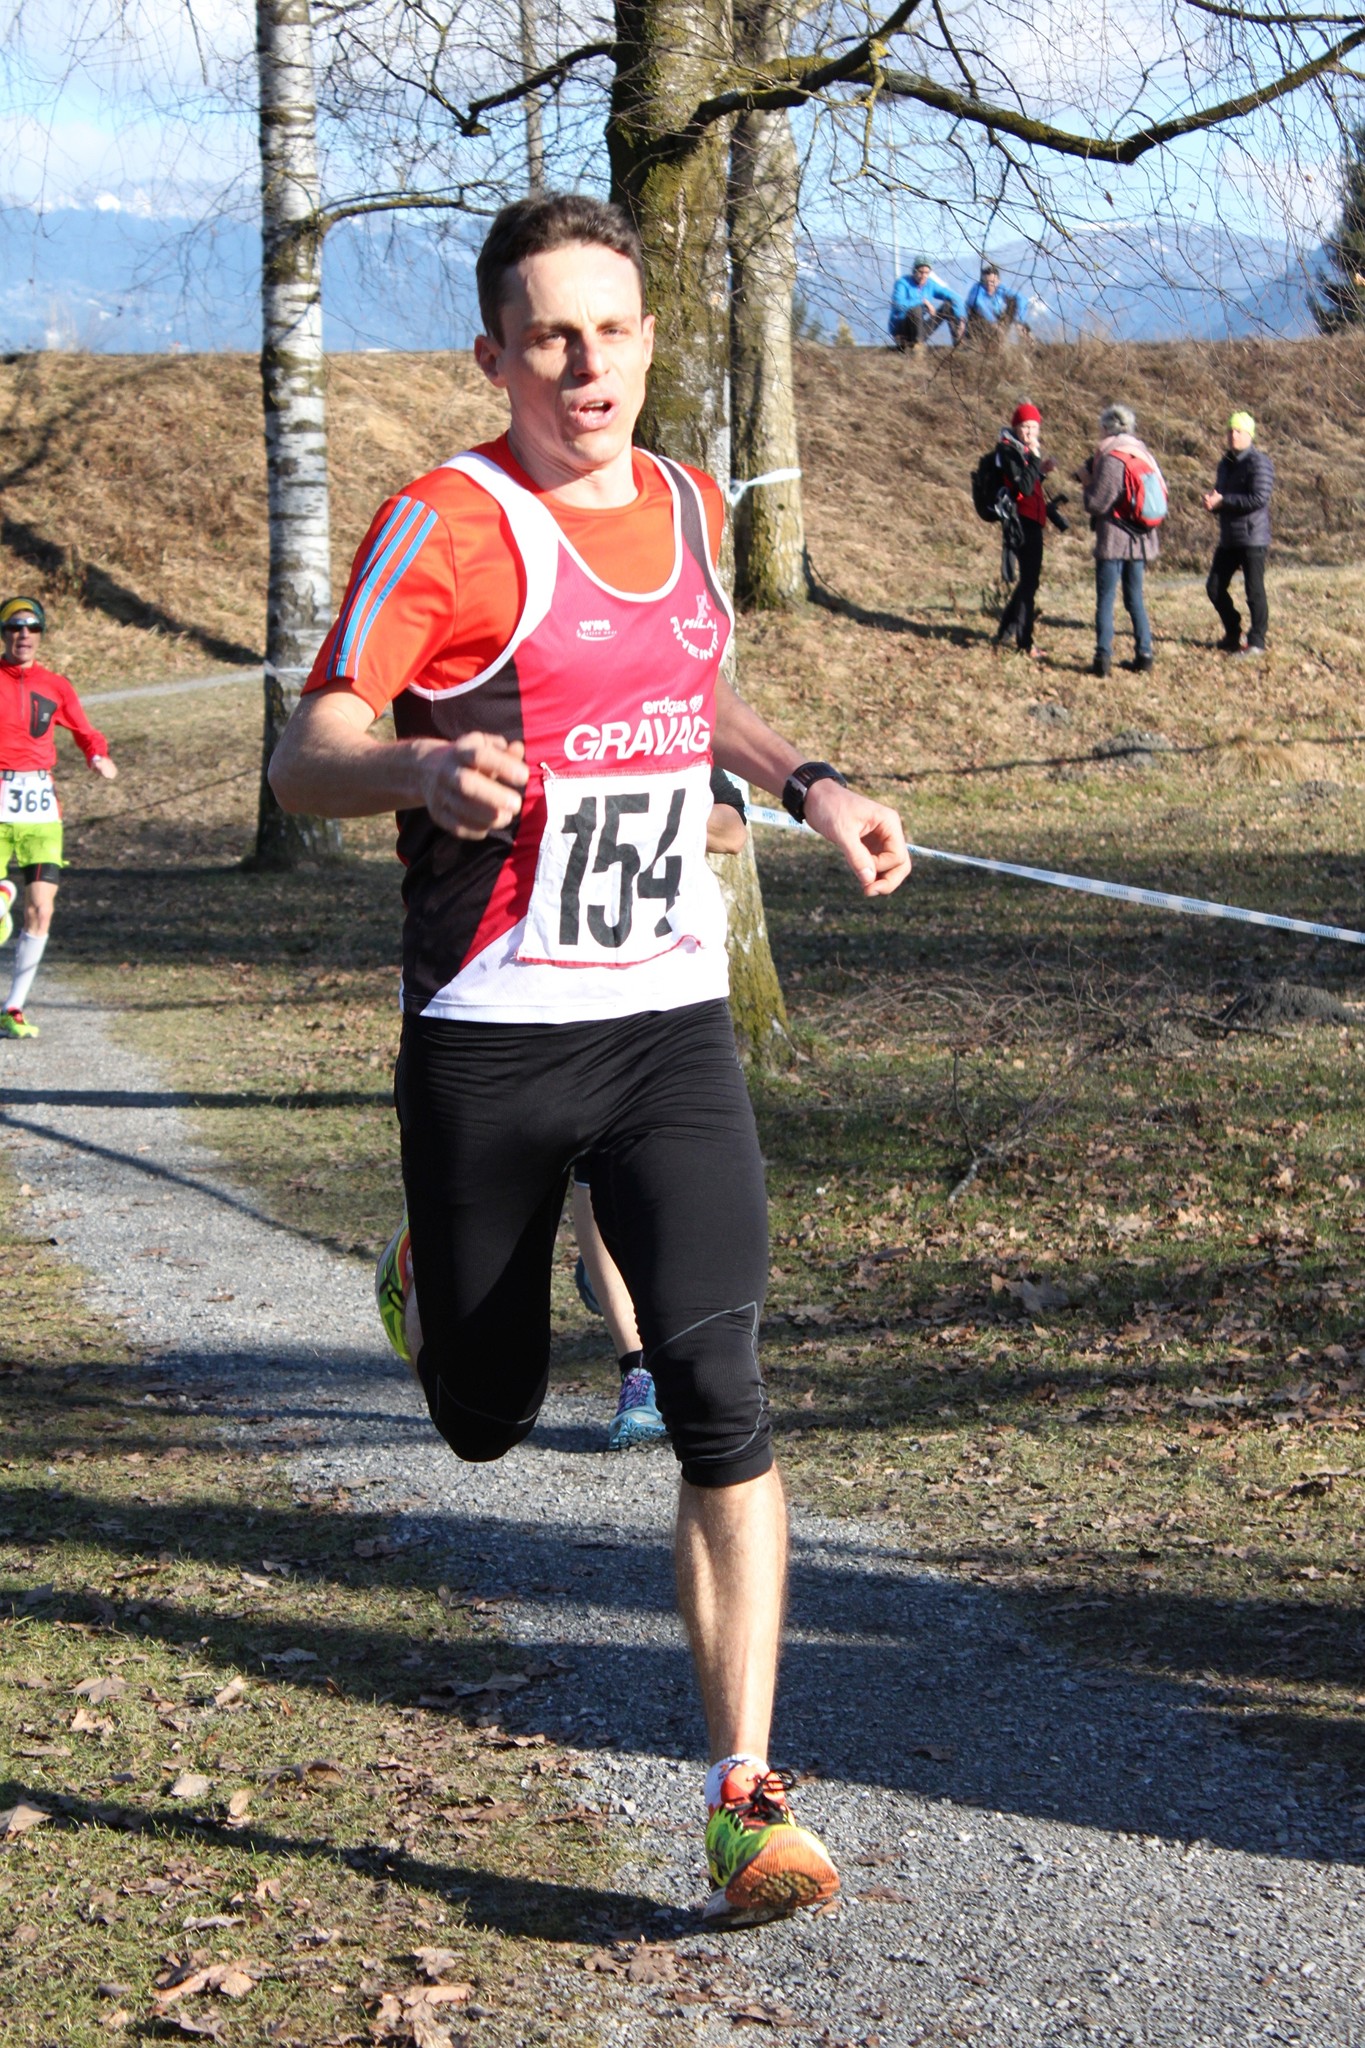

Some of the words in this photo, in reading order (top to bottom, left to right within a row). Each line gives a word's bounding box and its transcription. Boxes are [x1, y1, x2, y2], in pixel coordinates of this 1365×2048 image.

[642, 696, 688, 717] erdgas
[563, 715, 711, 762] GRAVAG
[9, 788, 51, 813] 366
[559, 788, 686, 948] 154
